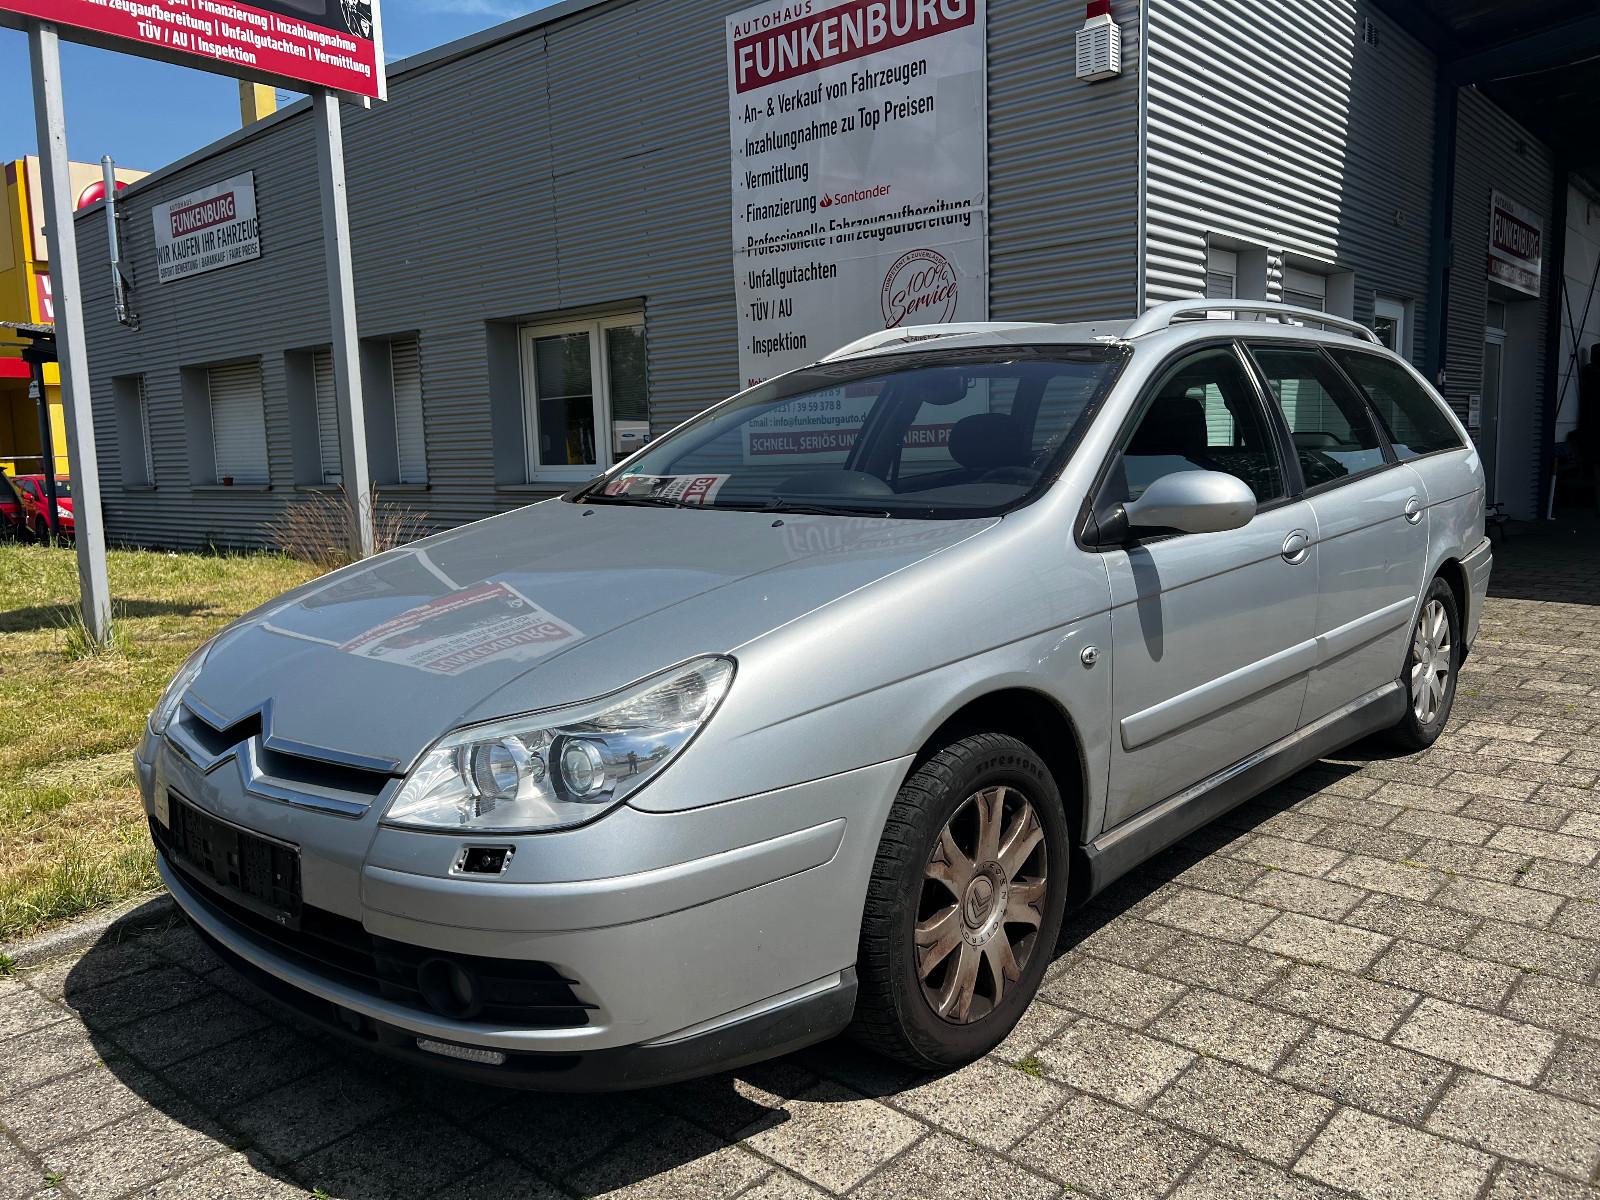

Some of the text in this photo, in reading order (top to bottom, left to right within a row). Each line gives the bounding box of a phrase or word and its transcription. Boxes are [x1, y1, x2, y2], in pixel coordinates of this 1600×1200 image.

[276, 18, 357, 53] Inzahlungnahme
[734, 0, 812, 38] AUTOHAUS
[137, 20, 161, 41] TÜV
[164, 27, 169, 43] /
[172, 32, 187, 47] AU
[198, 37, 257, 65] Inspektion
[221, 21, 306, 58] Unfallgutachten
[314, 46, 370, 78] Vermittlung
[738, 0, 967, 84] FUNKENBURG
[744, 58, 927, 124] An- & Verkauf von Fahrzeugen
[745, 95, 934, 158] Inzahlungnahme zu Top Preisen
[745, 162, 809, 190] Vermittlung
[171, 197, 234, 234] FUNKENBURG
[746, 185, 891, 222] Finanzierung Santander
[157, 218, 258, 265] WIR KAUFEN IHR FAHRZEUG
[747, 200, 971, 257] Professionelle Fahrzeugaufbereitung
[1494, 213, 1539, 259] FUNKENBURG
[748, 262, 837, 290] Unfallgutachten
[907, 263, 948, 296] 100%
[750, 298, 793, 322] TÜV / AU
[886, 282, 957, 329] Service
[752, 332, 807, 357] Inspektion
[774, 413, 866, 427] info@funkenburgauto.d
[797, 402, 807, 412] 39
[808, 401, 818, 411] 59
[752, 437, 798, 451] SCHNELL,
[800, 434, 836, 449] SERIÖS
[839, 432, 858, 446] UN
